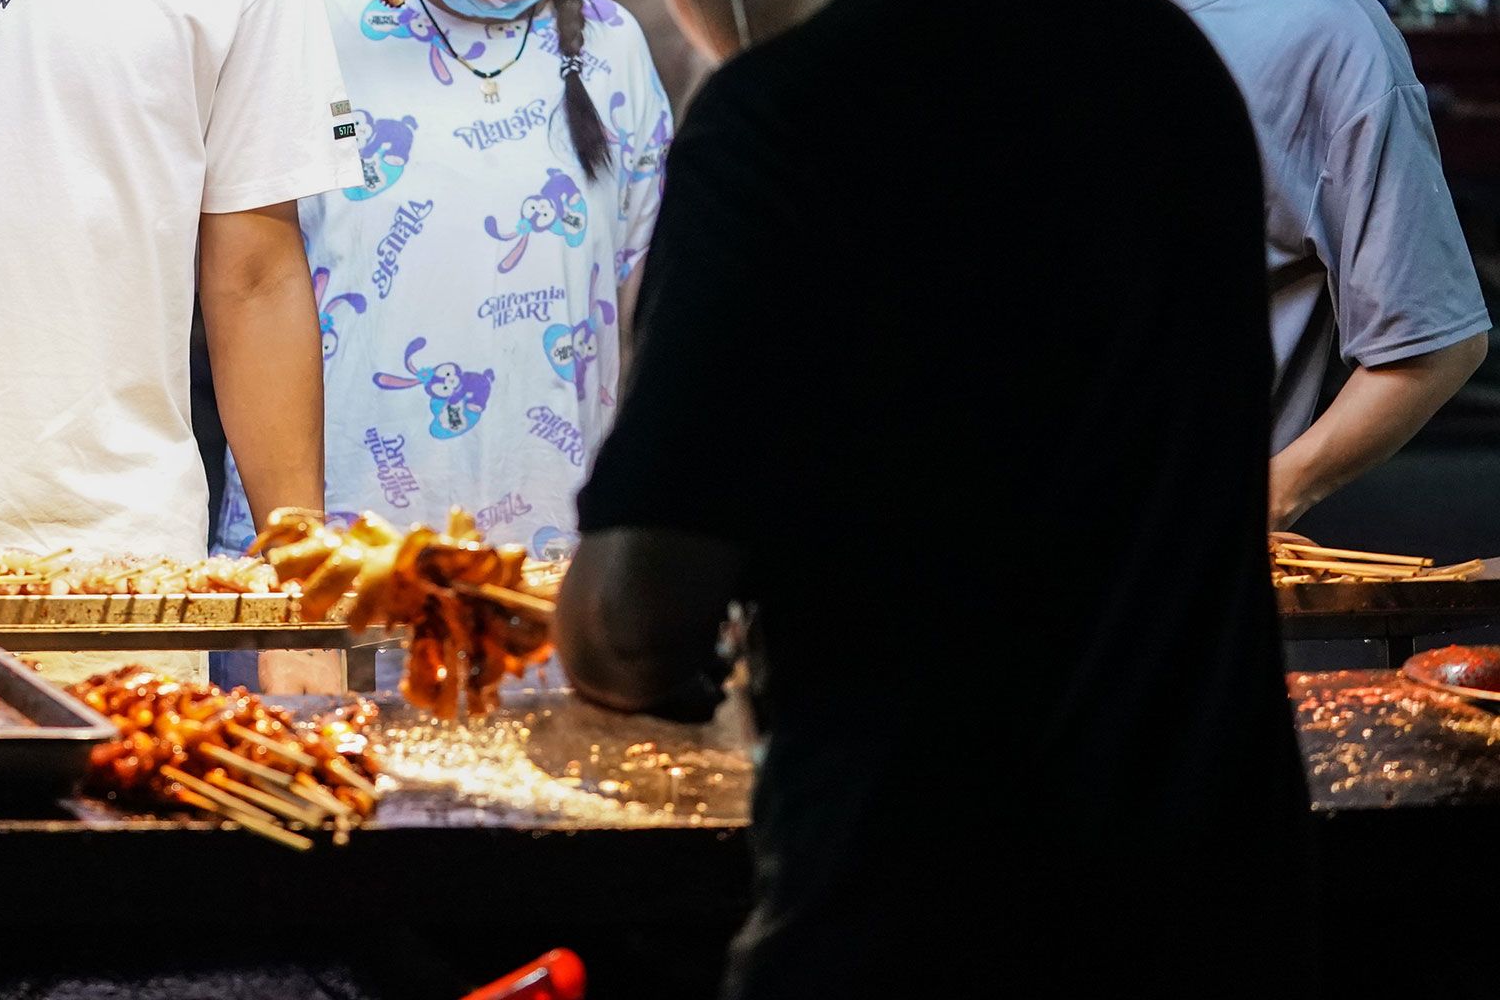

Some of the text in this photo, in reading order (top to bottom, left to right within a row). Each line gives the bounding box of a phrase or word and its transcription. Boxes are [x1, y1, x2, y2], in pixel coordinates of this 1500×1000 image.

[477, 285, 565, 319] California
[492, 301, 554, 330] HEART
[364, 427, 410, 508] California
[381, 434, 420, 492] HEART
